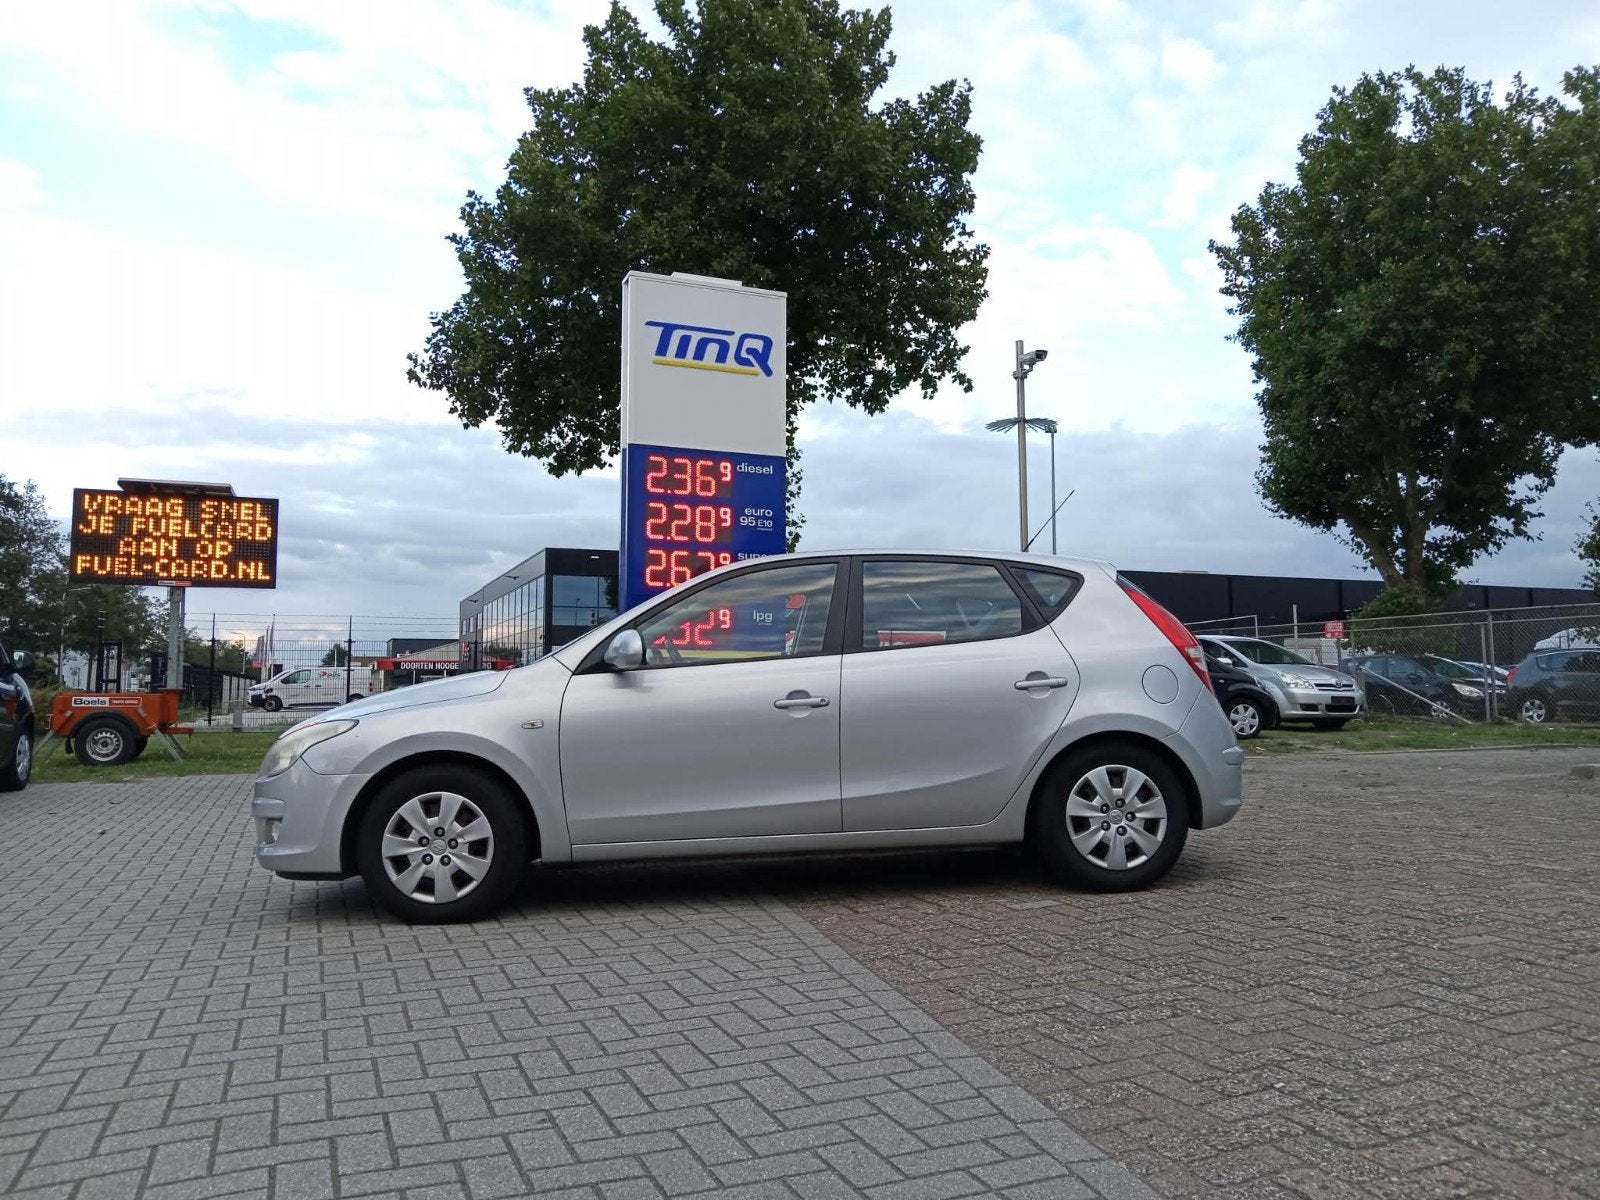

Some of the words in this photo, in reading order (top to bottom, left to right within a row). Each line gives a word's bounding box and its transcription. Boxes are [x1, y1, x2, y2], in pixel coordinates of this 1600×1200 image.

[736, 462, 773, 475] diesel
[83, 493, 184, 518] VRAAG
[200, 500, 269, 521] SNEL
[744, 507, 773, 517] euro
[78, 514, 115, 535] JE
[132, 517, 272, 541] FUELCARD
[739, 516, 756, 527] 95
[757, 519, 773, 528] E10
[119, 537, 178, 557] AAN
[196, 540, 233, 559] OP
[76, 555, 271, 580] FUEL-CARD.NL
[753, 610, 773, 622] lpg
[73, 698, 107, 706] Boels
